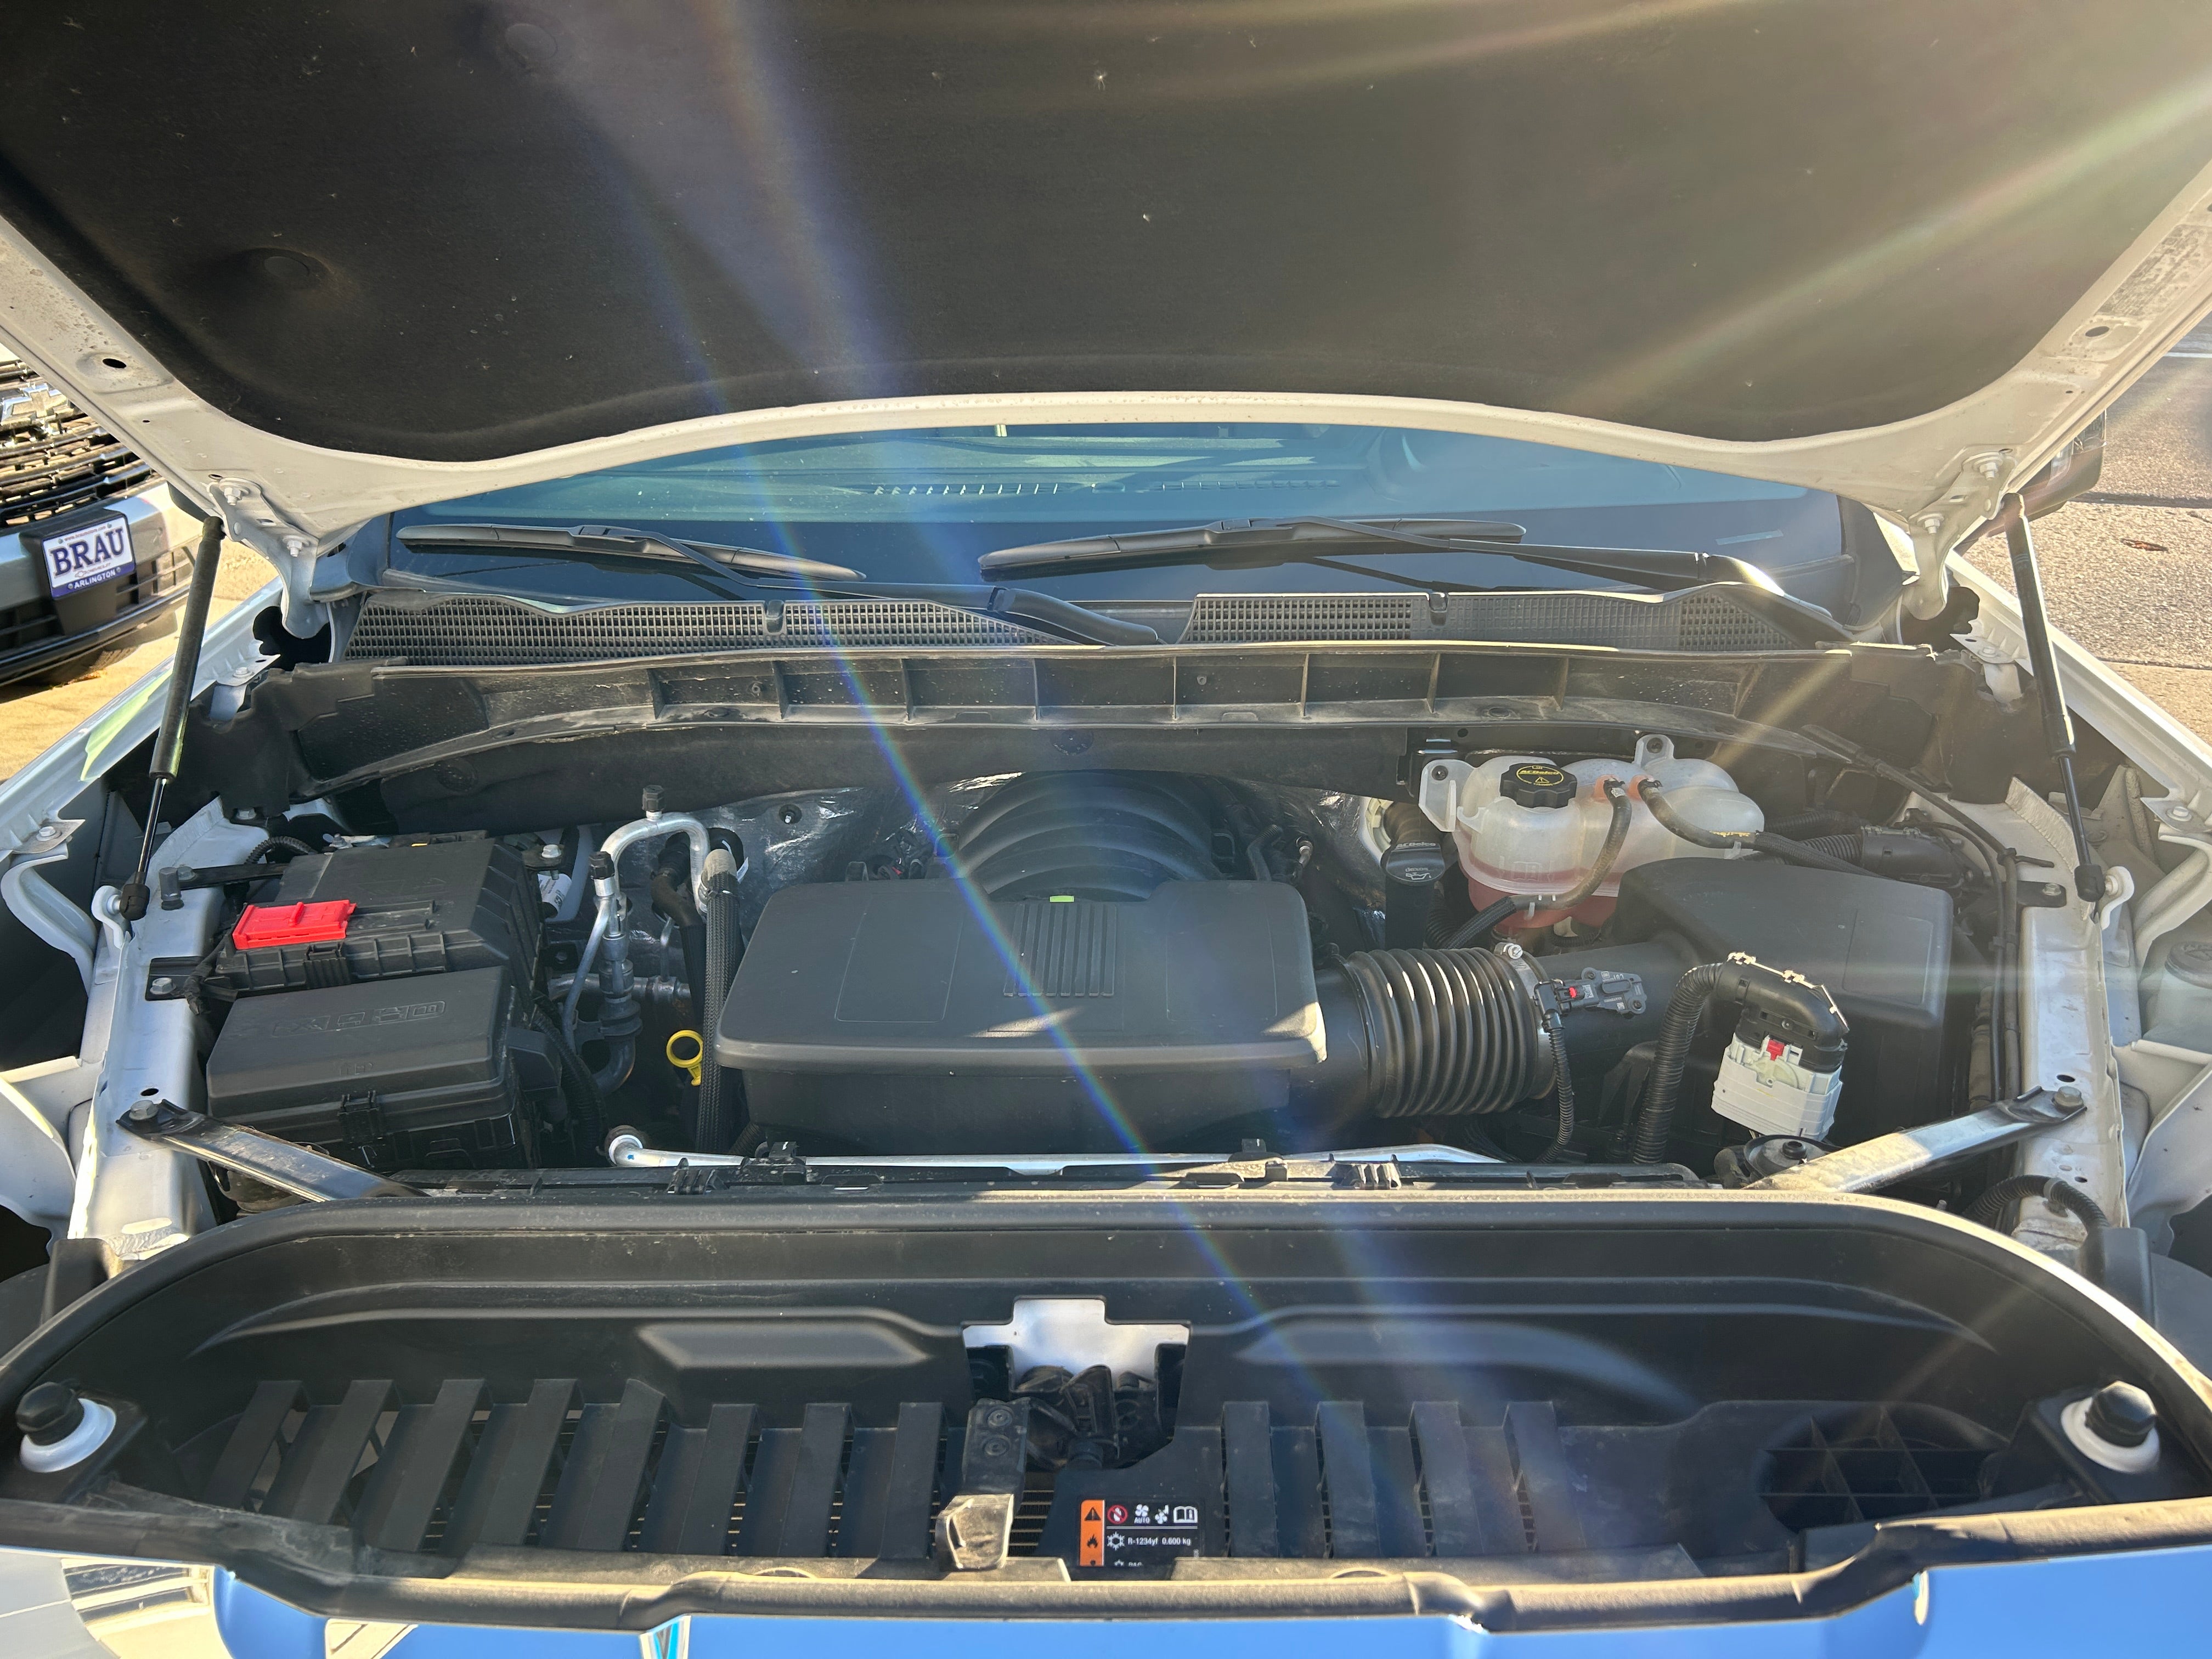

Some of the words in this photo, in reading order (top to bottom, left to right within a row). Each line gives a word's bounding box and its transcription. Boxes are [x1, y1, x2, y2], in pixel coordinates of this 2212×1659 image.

[50, 528, 123, 577] BRAU
[74, 569, 116, 589] ARLINGTON
[1127, 1537, 1158, 1546] R-1234yf
[1182, 1537, 1192, 1546] kg
